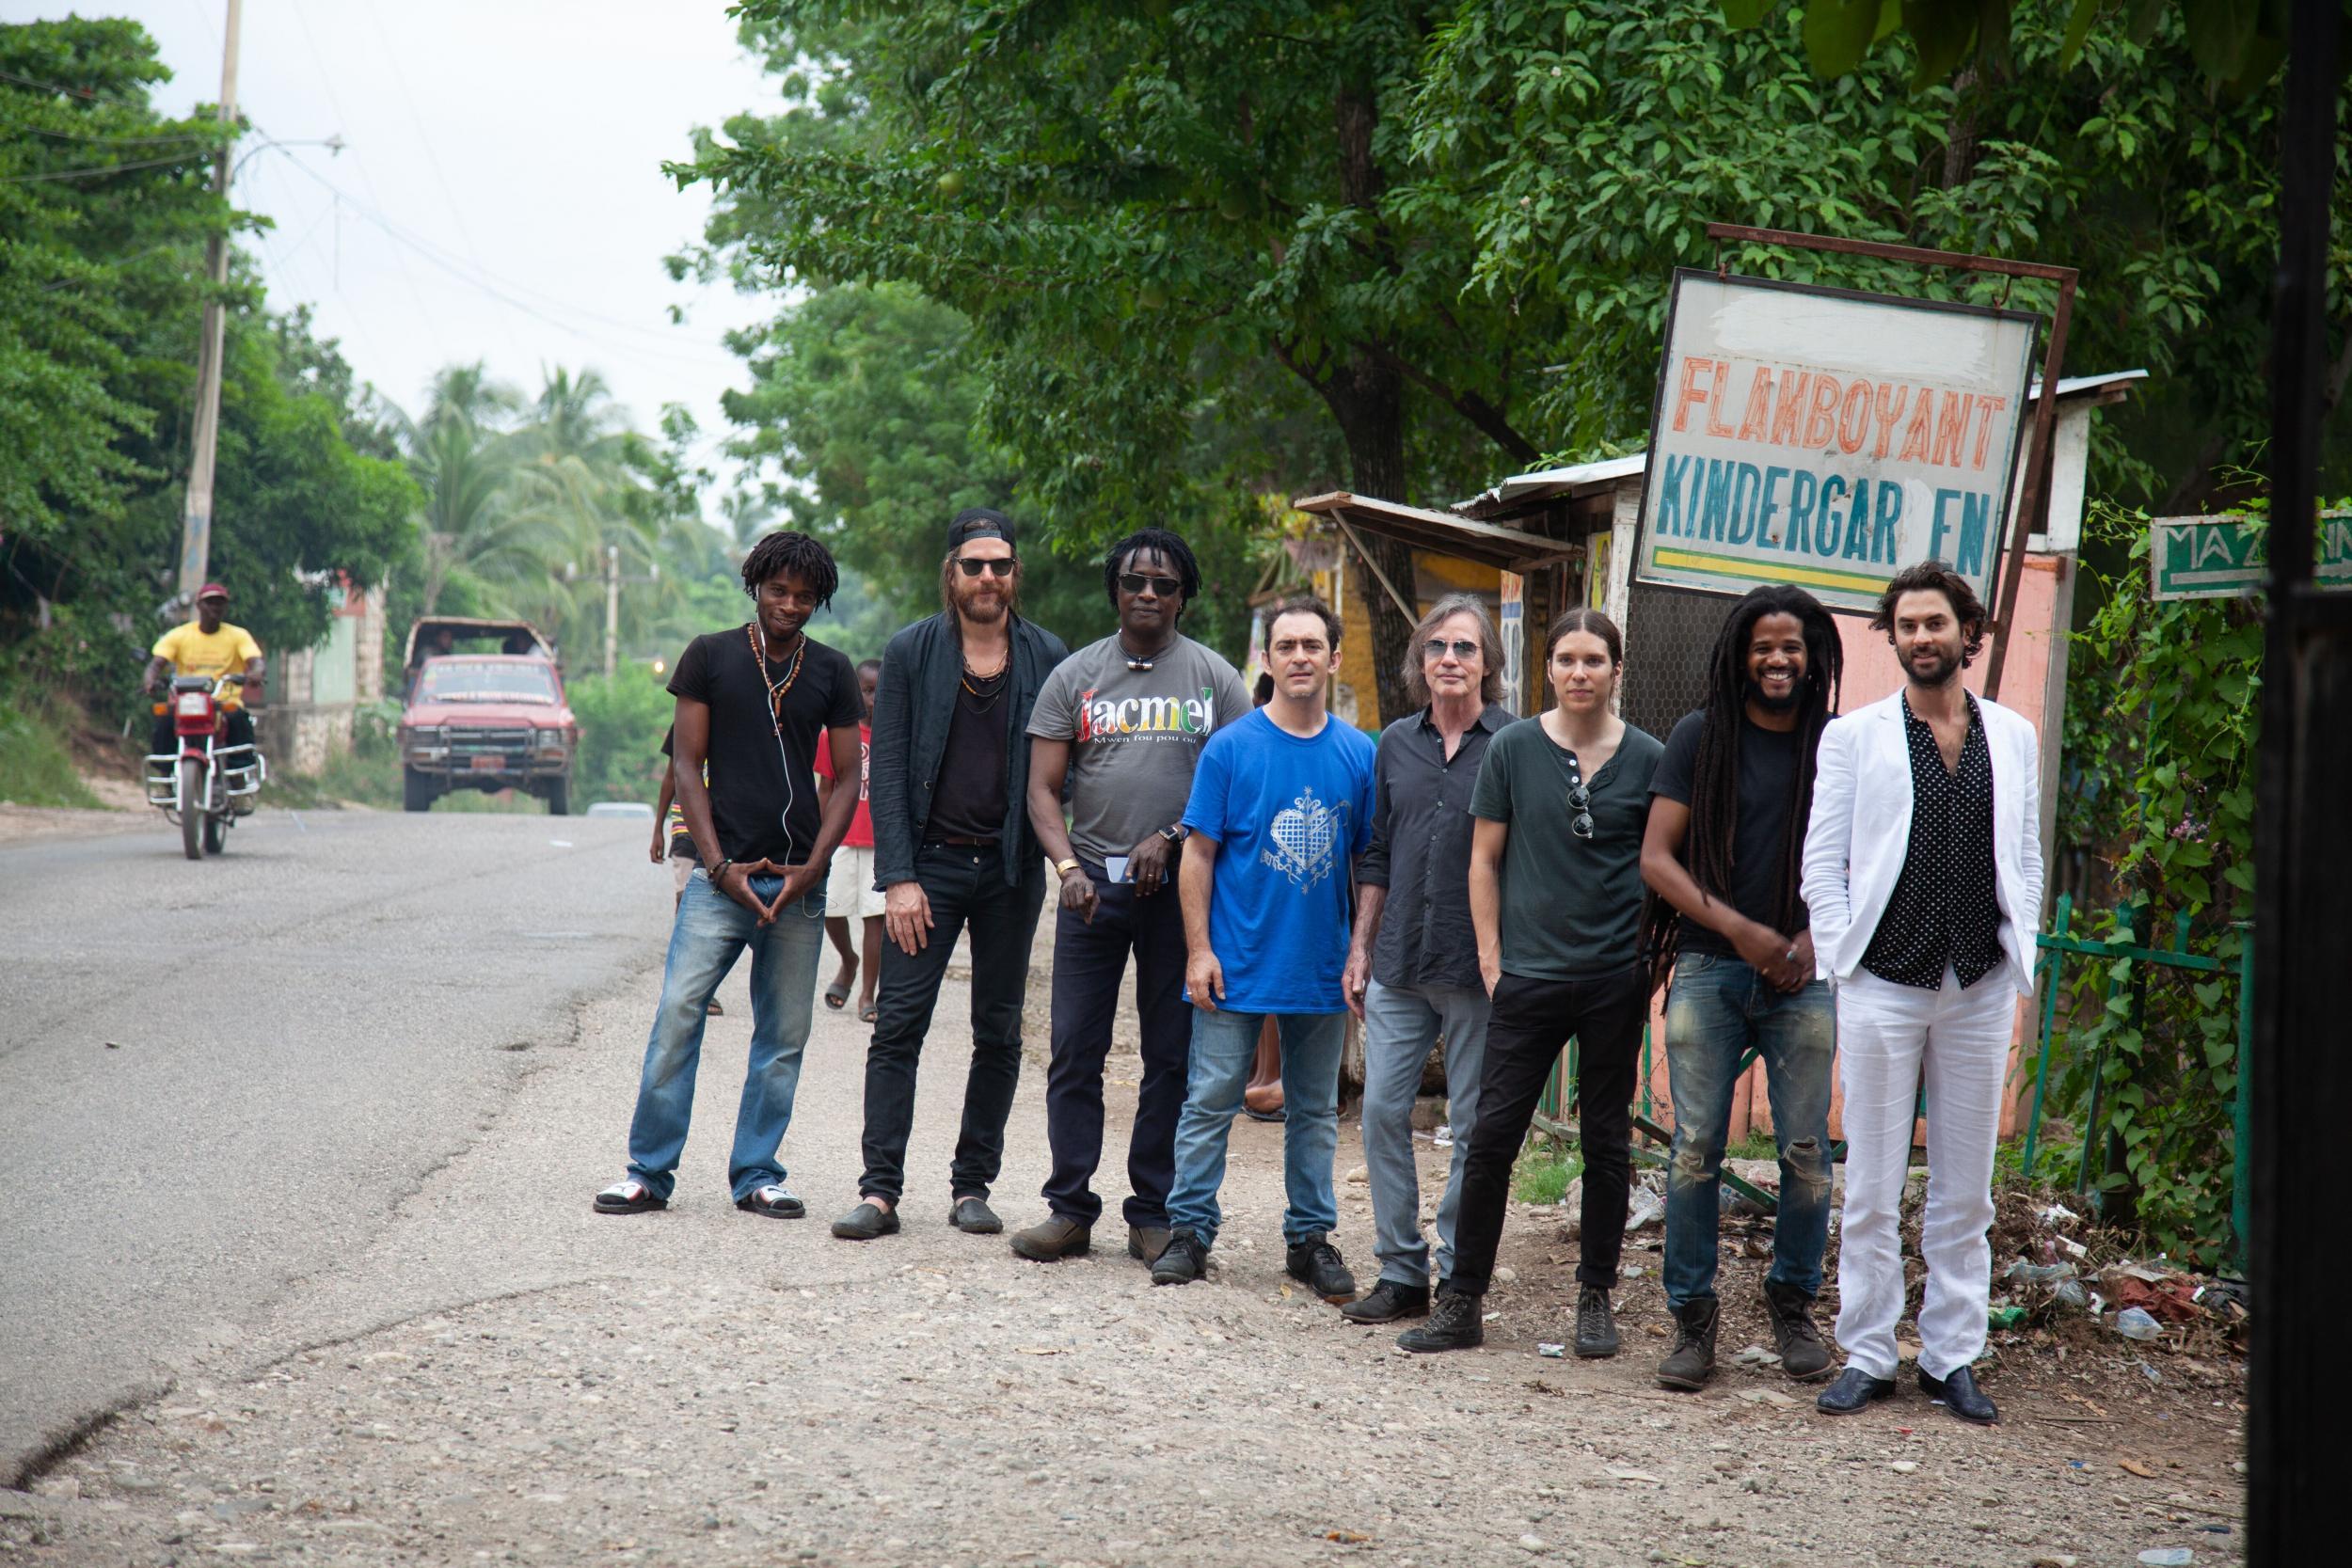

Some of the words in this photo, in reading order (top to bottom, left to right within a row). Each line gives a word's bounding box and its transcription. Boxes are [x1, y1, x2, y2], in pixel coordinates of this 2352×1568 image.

[1672, 356, 2007, 471] FLAMBOYANT
[1075, 687, 1214, 743] Jacmel
[1093, 736, 1130, 745] Mwen
[1133, 734, 1153, 742] fou
[1155, 735, 1180, 743] pou
